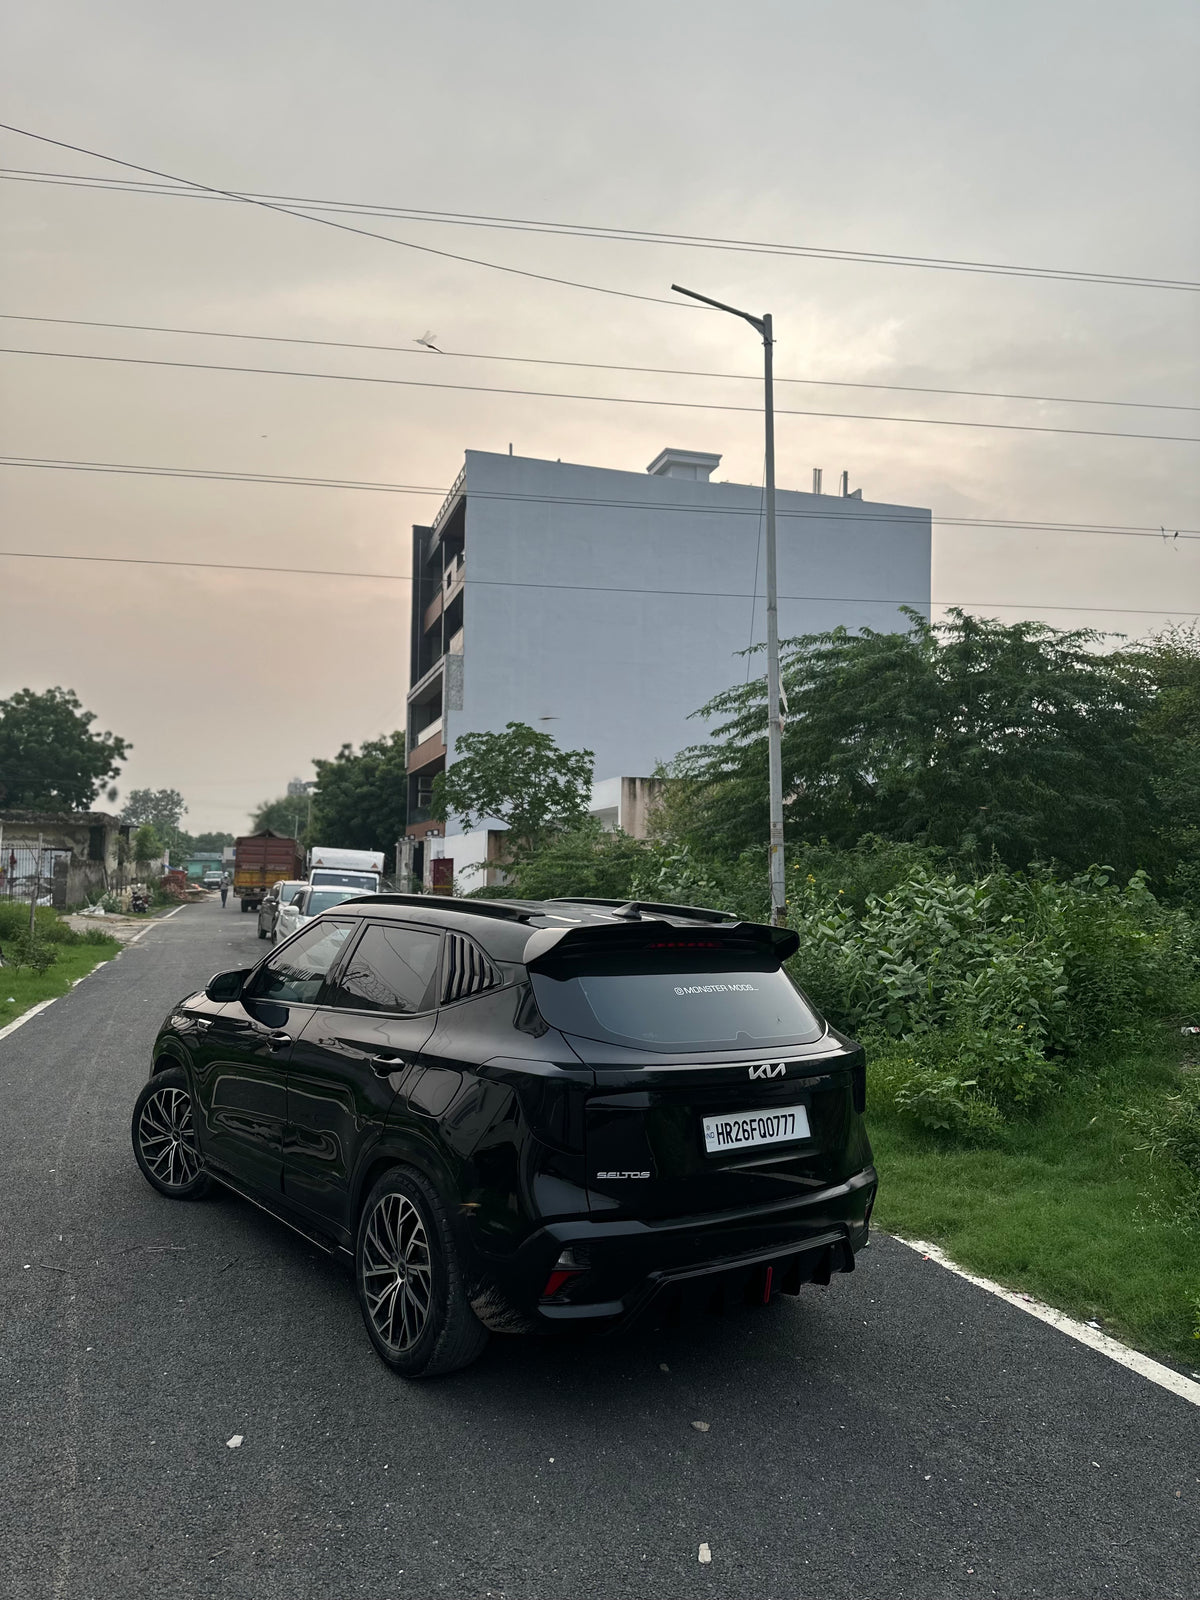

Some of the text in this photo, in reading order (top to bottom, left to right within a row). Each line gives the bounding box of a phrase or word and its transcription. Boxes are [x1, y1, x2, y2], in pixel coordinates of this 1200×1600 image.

[748, 1063, 787, 1080] KIA
[715, 1113, 796, 1145] HR26FQ0777
[596, 1171, 651, 1179] SELTOS
